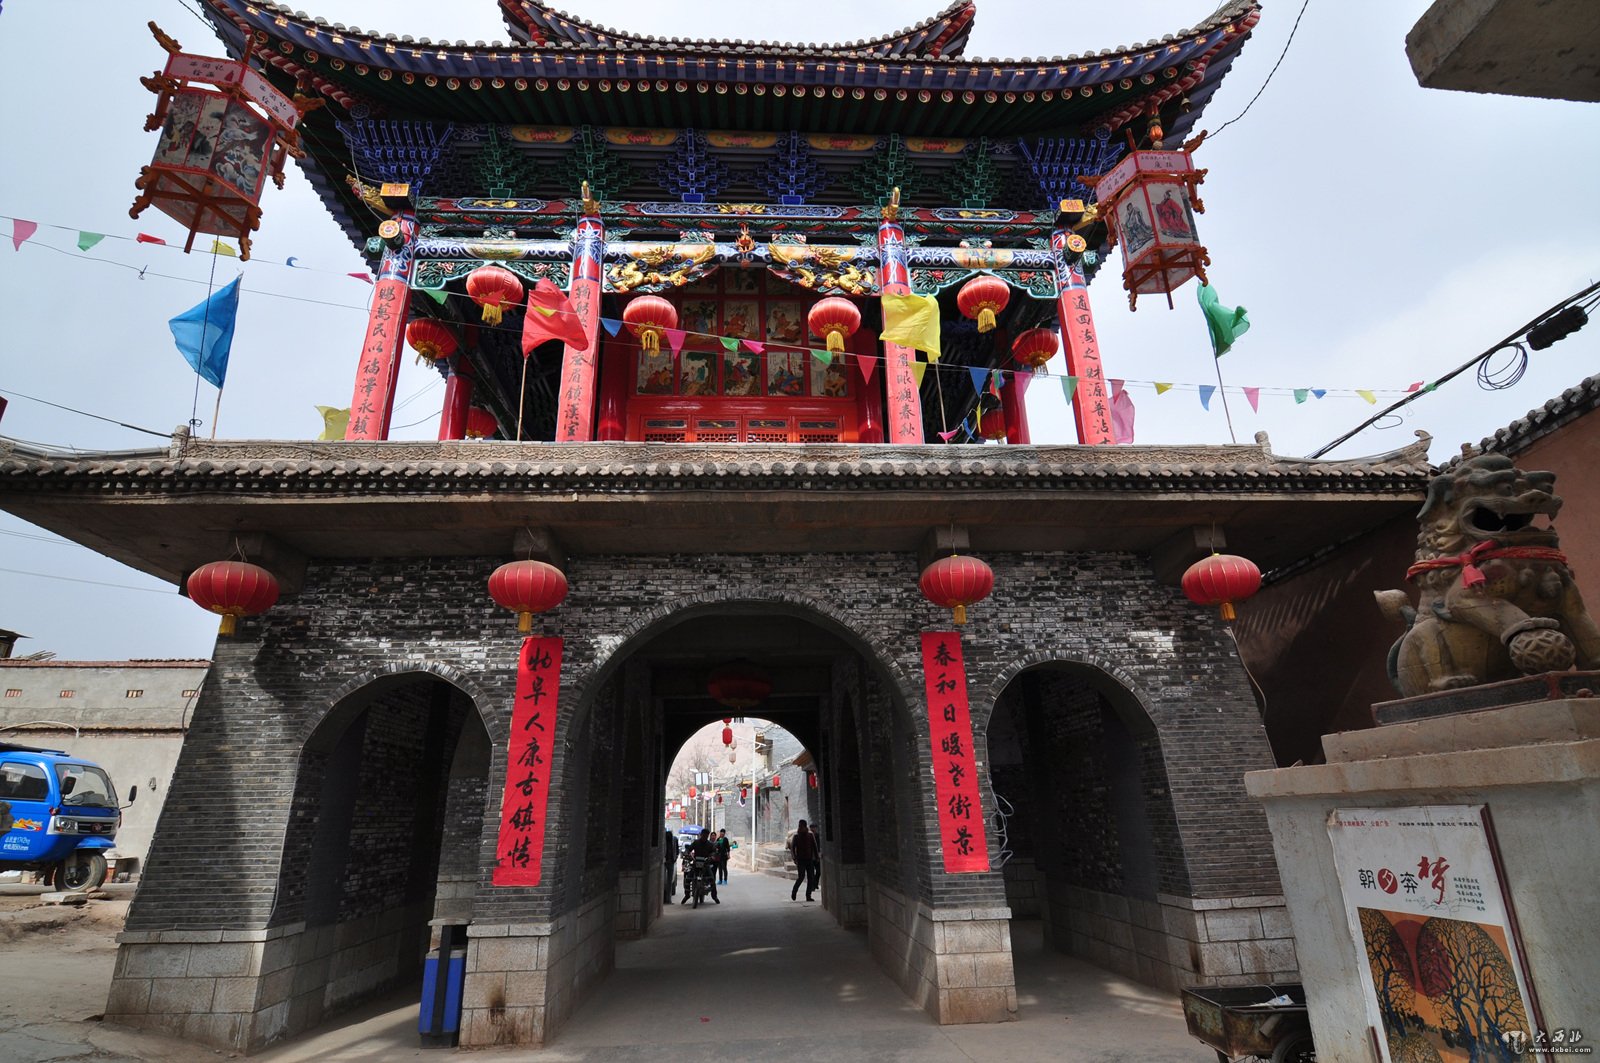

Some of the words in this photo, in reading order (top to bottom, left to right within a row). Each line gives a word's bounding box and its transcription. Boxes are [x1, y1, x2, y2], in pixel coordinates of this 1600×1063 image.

[507, 647, 553, 869] 物阜人康古鎮情
[933, 641, 974, 856] 春和日暖老街景
